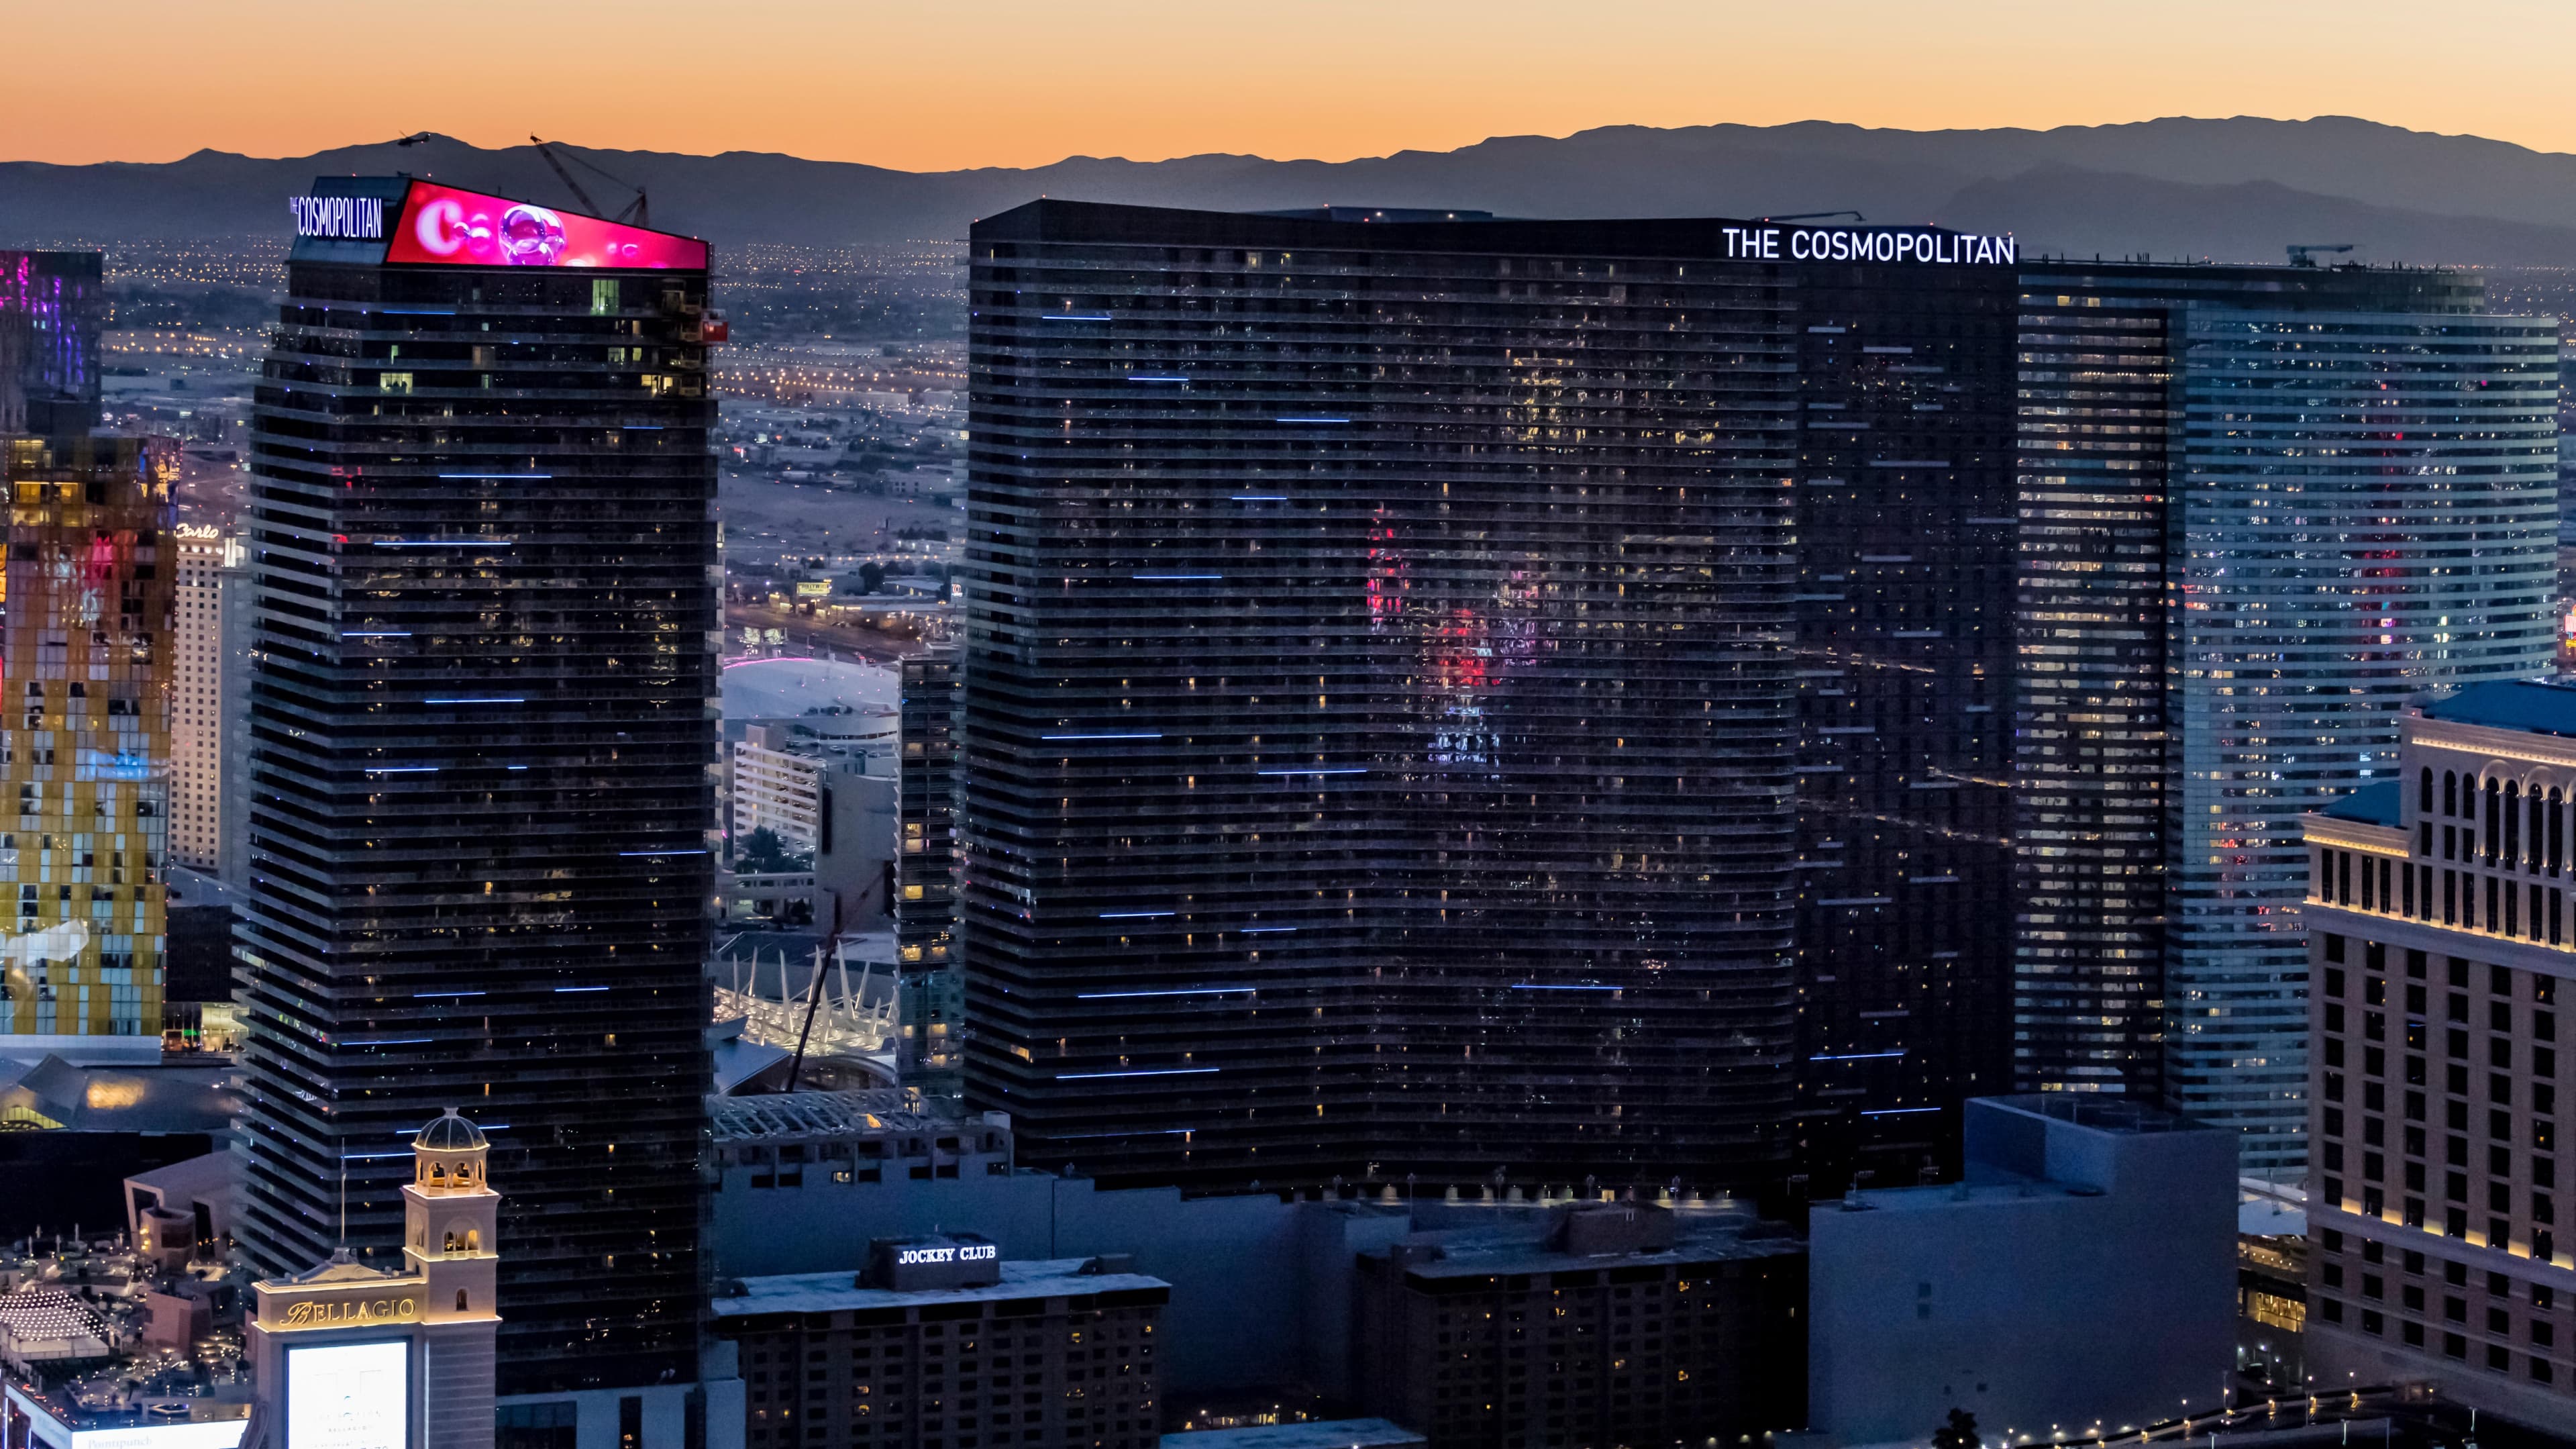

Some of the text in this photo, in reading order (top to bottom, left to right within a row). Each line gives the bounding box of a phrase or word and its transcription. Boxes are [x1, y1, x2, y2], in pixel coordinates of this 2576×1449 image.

[298, 196, 382, 238] COSMOPOLITAN
[1722, 228, 2014, 264] THE COSMOPOLITAN
[176, 523, 219, 538] Carlo
[899, 1245, 996, 1264] JOCKEY CLUB
[280, 1299, 416, 1326] BELLAGIO
